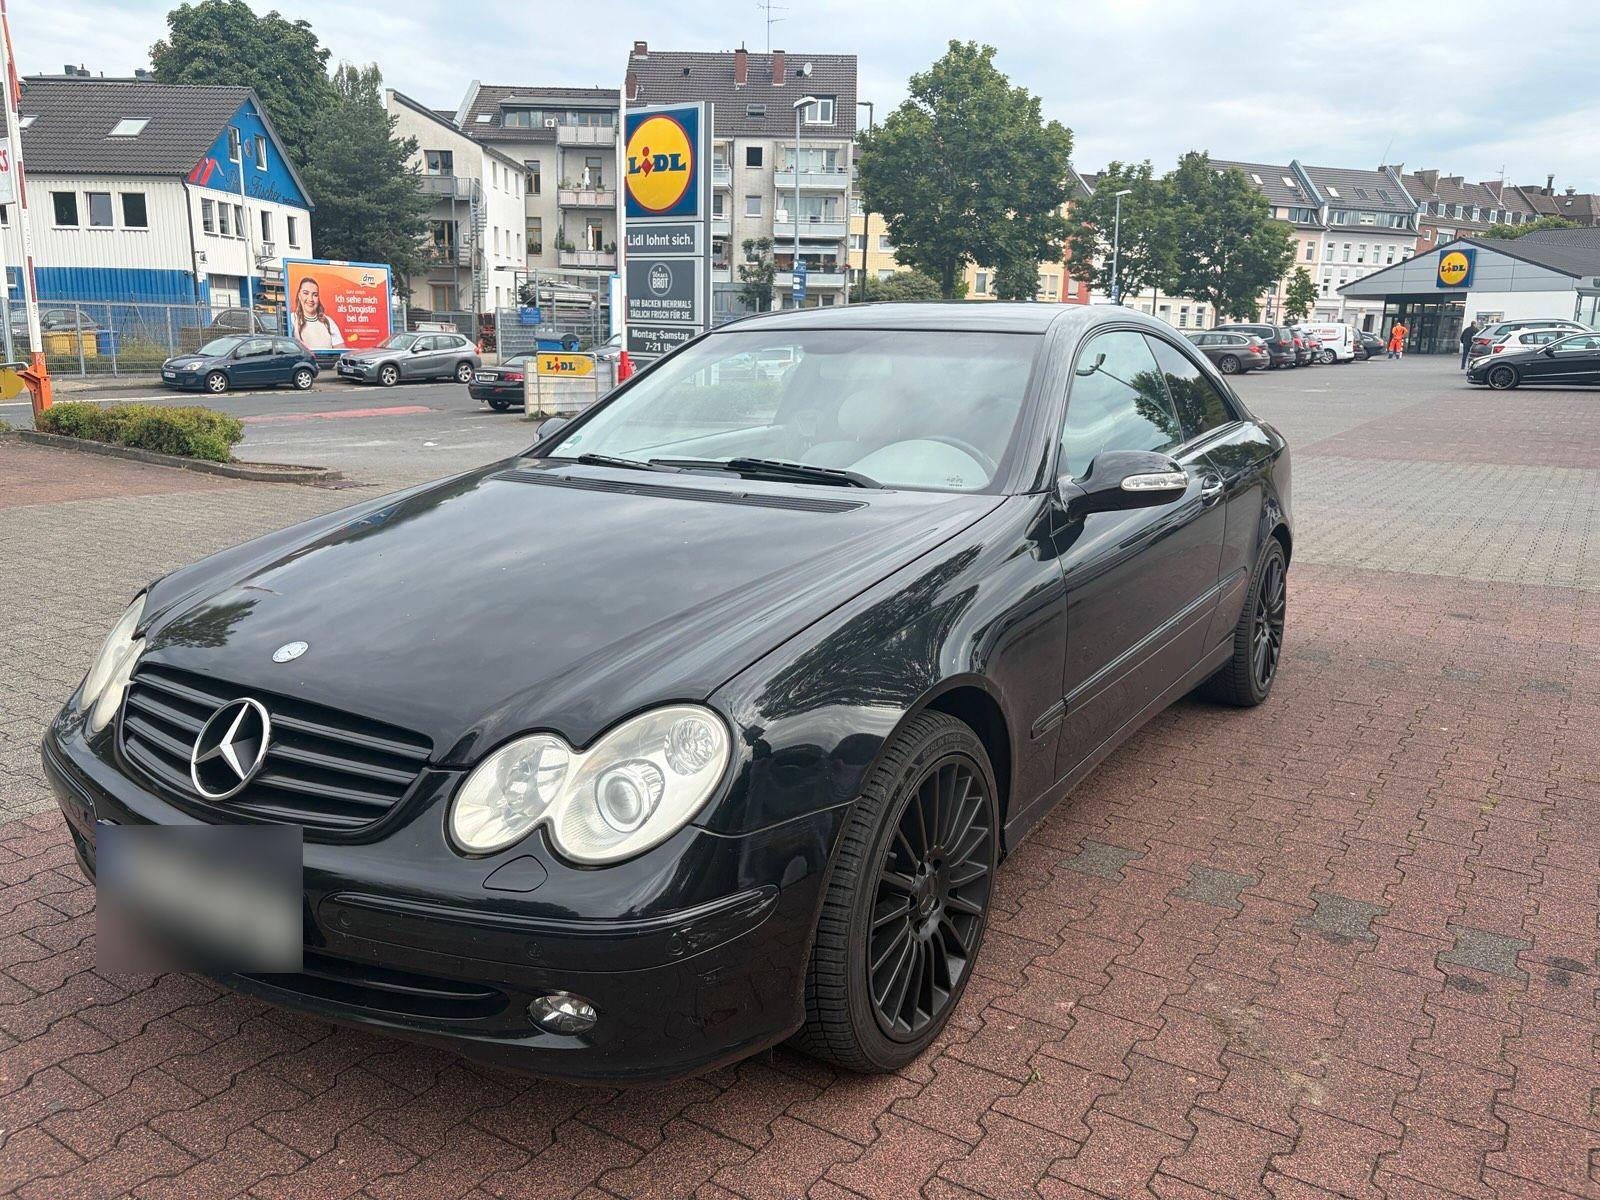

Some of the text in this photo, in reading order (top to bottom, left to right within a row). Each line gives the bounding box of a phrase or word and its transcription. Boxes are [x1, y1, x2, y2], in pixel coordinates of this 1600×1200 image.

[627, 233, 694, 246] Lidl lohnt sich.
[362, 274, 375, 282] dm
[652, 277, 669, 289] BROT
[335, 294, 378, 304] Ich sehe mich
[630, 299, 692, 309] WIR BACKEN MEHRMALS
[348, 305, 376, 315] Drogistin
[630, 308, 650, 318] TÄGLICH
[651, 310, 669, 319] FRISCH
[670, 309, 680, 319] FÜR
[346, 315, 369, 323] bei dm
[631, 329, 690, 341] Montag-Samstag
[645, 342, 661, 351] 7-21
